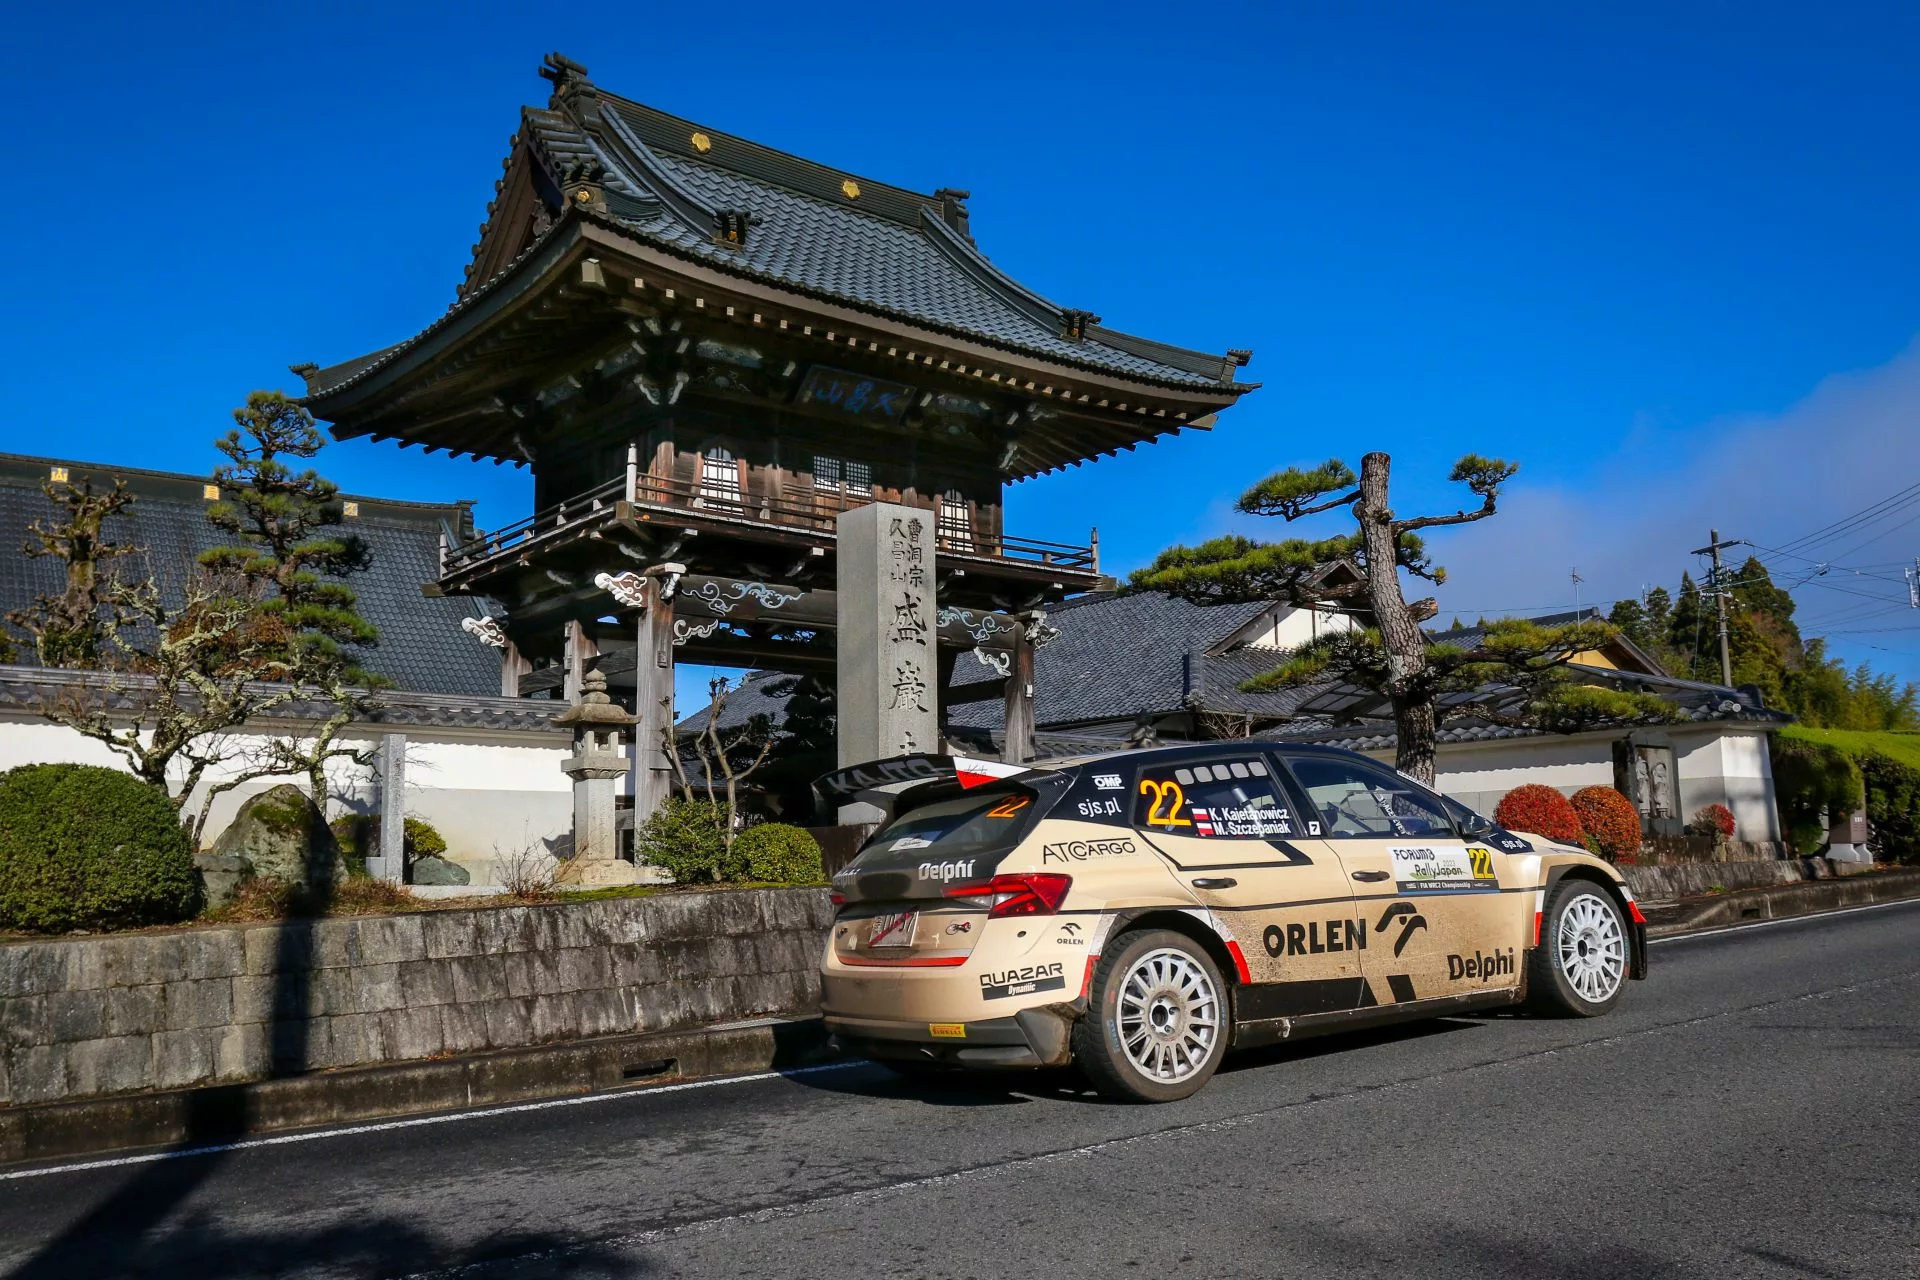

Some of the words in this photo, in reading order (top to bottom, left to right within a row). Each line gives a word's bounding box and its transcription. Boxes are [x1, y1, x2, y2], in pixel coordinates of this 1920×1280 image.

[889, 517, 907, 583] 久昌山
[1093, 775, 1123, 788] OMP
[986, 795, 1029, 818] 22
[1078, 798, 1122, 817] sjs.pl
[1139, 779, 1192, 826] 22
[1210, 808, 1222, 821] K.
[1224, 807, 1290, 823] Kajetanowicz
[1214, 822, 1227, 836] M.
[1228, 821, 1291, 837] Szczepaniak
[1501, 838, 1525, 851] sjs.pl
[919, 859, 976, 882] Delphi
[1468, 848, 1495, 879] 22
[1442, 881, 1471, 890] Championship
[1057, 938, 1084, 946] ORLEN
[1263, 919, 1367, 958] ORLEN
[980, 962, 1063, 988] QUAZAR
[1447, 948, 1514, 982] Delphi
